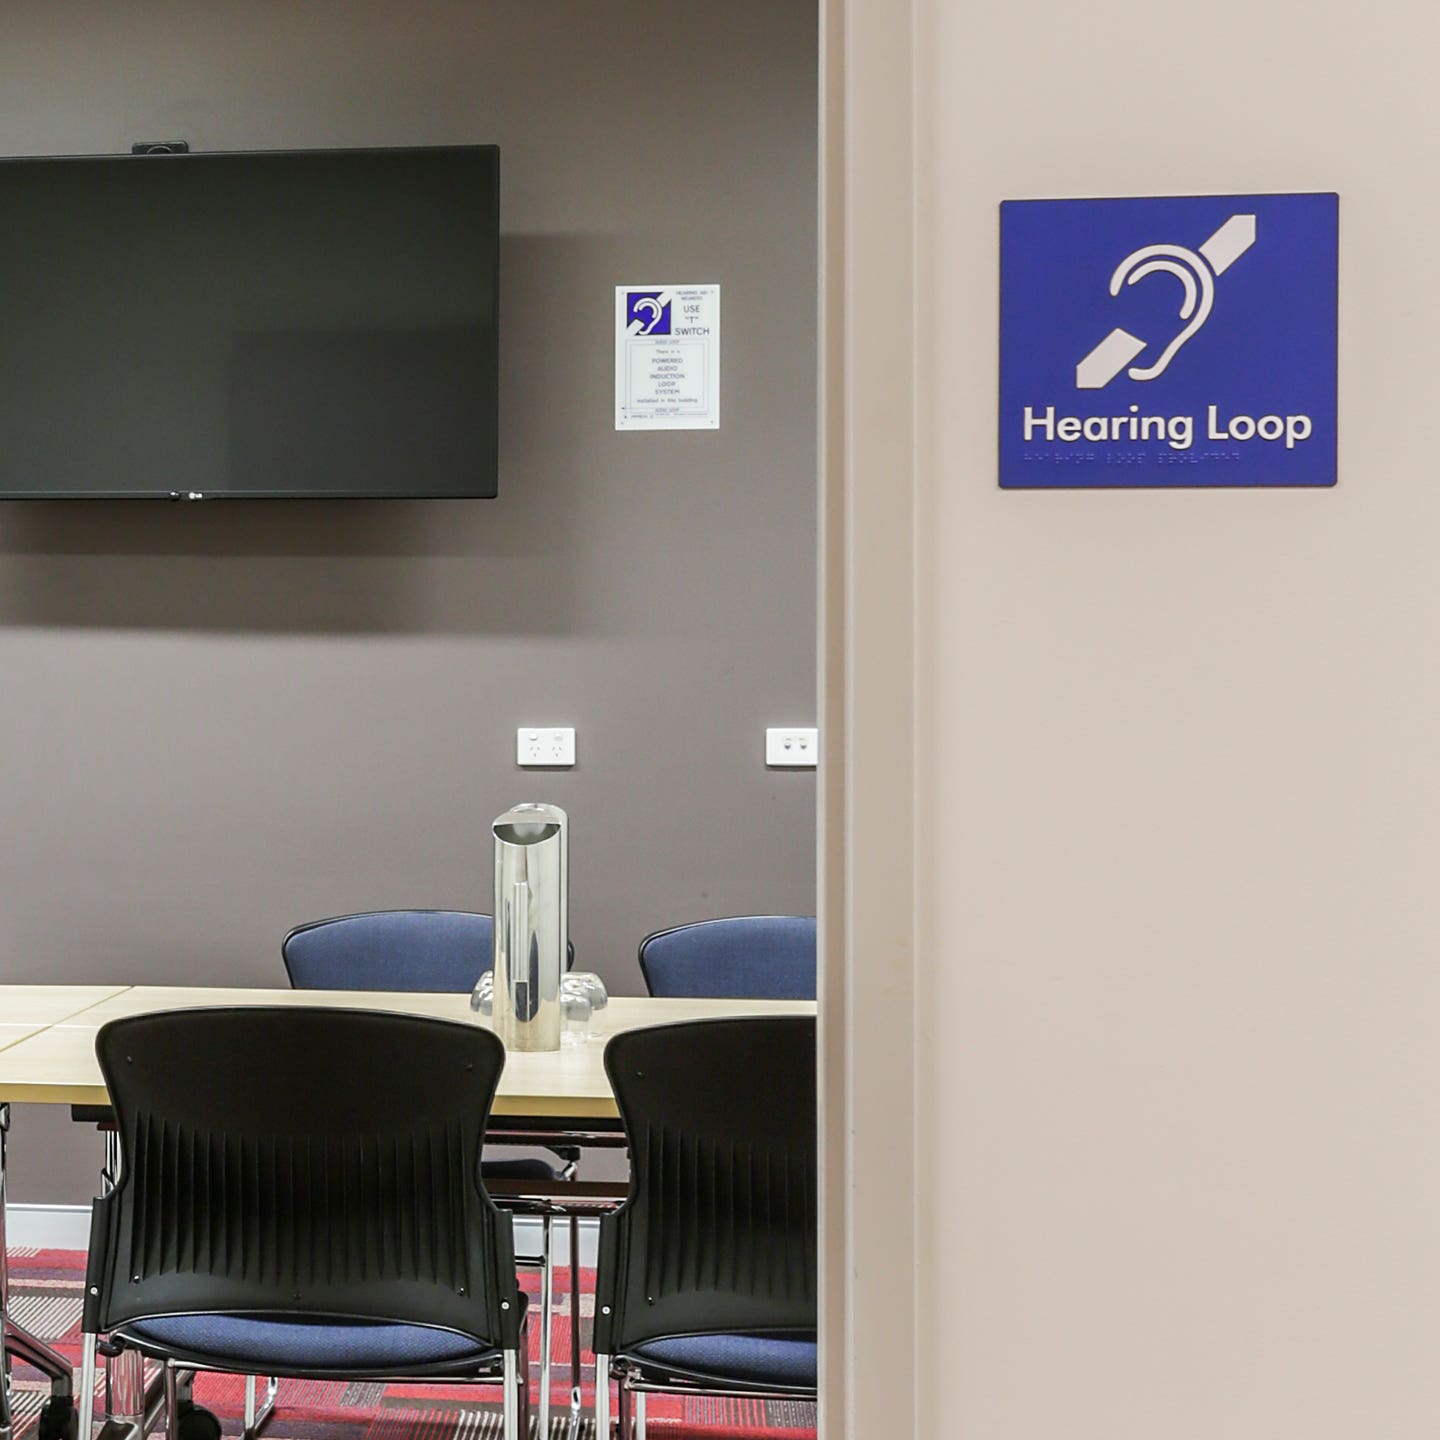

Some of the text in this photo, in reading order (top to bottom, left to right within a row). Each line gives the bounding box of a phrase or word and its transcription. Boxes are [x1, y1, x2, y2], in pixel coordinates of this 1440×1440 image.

[683, 304, 700, 313] USE
[675, 327, 710, 336] SWITCH
[1023, 405, 1312, 450] Hearing Loop
